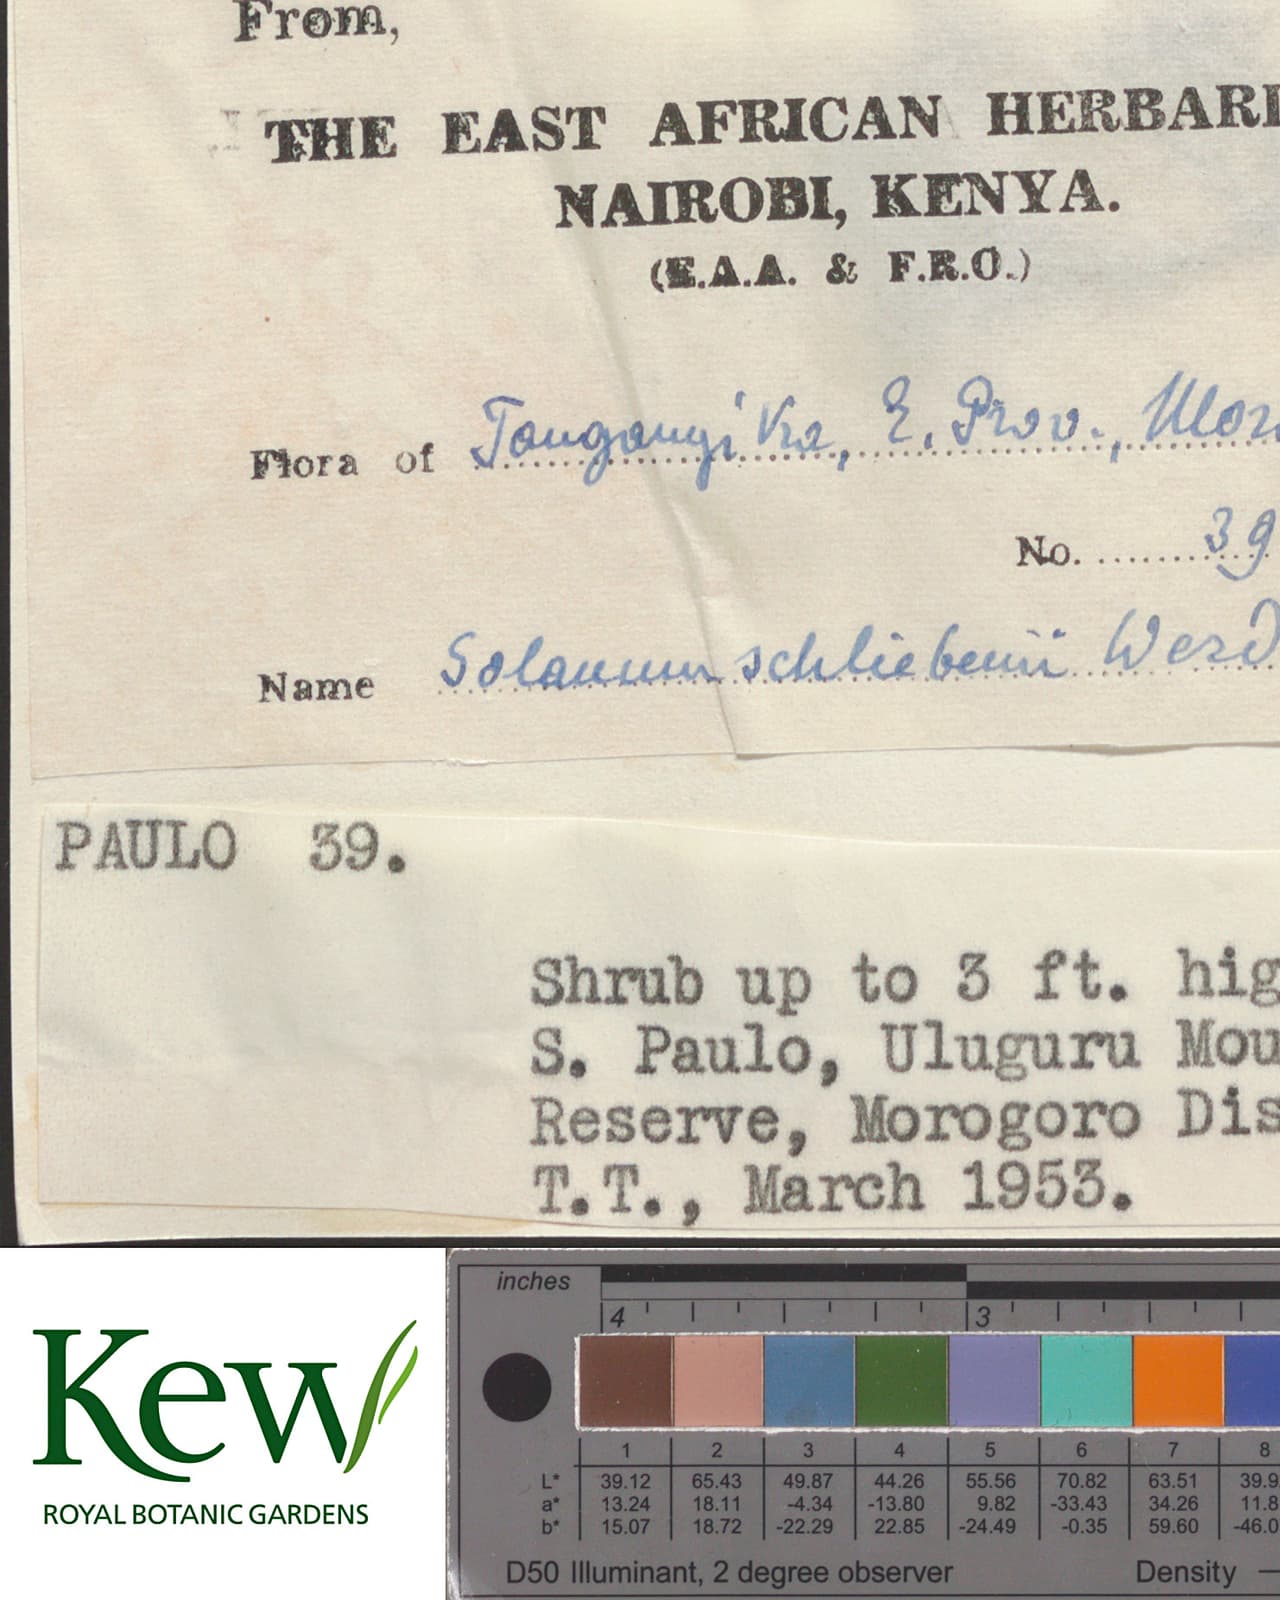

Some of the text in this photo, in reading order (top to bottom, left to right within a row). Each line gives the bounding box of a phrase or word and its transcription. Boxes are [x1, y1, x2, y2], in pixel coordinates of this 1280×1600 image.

[265, 116, 397, 163] THE
[442, 106, 606, 154] EAST
[649, 95, 942, 147] AFRICAN
[554, 169, 1119, 230] NAIROBI, KENYA.
[651, 246, 1030, 293] (E.A.A. & F.R.O.)
[250, 442, 434, 480] Flora of
[1016, 536, 1080, 566] No.
[1204, 507, 1277, 582] 39
[258, 672, 374, 702] Name
[56, 819, 406, 874] PAULO 39.
[532, 955, 703, 1007] Shrub
[736, 967, 811, 1017] up
[852, 952, 918, 1004] to
[958, 952, 989, 1002] 3
[1035, 949, 1128, 1002] ft.
[531, 1028, 586, 1079] S.
[635, 1022, 838, 1088] Paulo,
[880, 1019, 1141, 1082] Uluguru
[530, 1097, 806, 1157] Reserve,
[850, 1094, 1141, 1152] Morogoro
[534, 1158, 1132, 1230] T.T., March 1953.
[497, 1271, 570, 1290] inches
[609, 1307, 625, 1328] 4
[976, 1307, 991, 1328] 3
[601, 1474, 650, 1489] 39.12
[692, 1473, 742, 1489] 65.43
[784, 1473, 833, 1488] 49.87
[874, 1473, 924, 1488] 44.26
[966, 1473, 1016, 1488] 55.56
[1058, 1473, 1106, 1488] 70.82
[1149, 1473, 1196, 1488] 63.51
[507, 1560, 954, 1589] D50 Illuminant, 2 degree observer
[1137, 1560, 1236, 1589] Density
